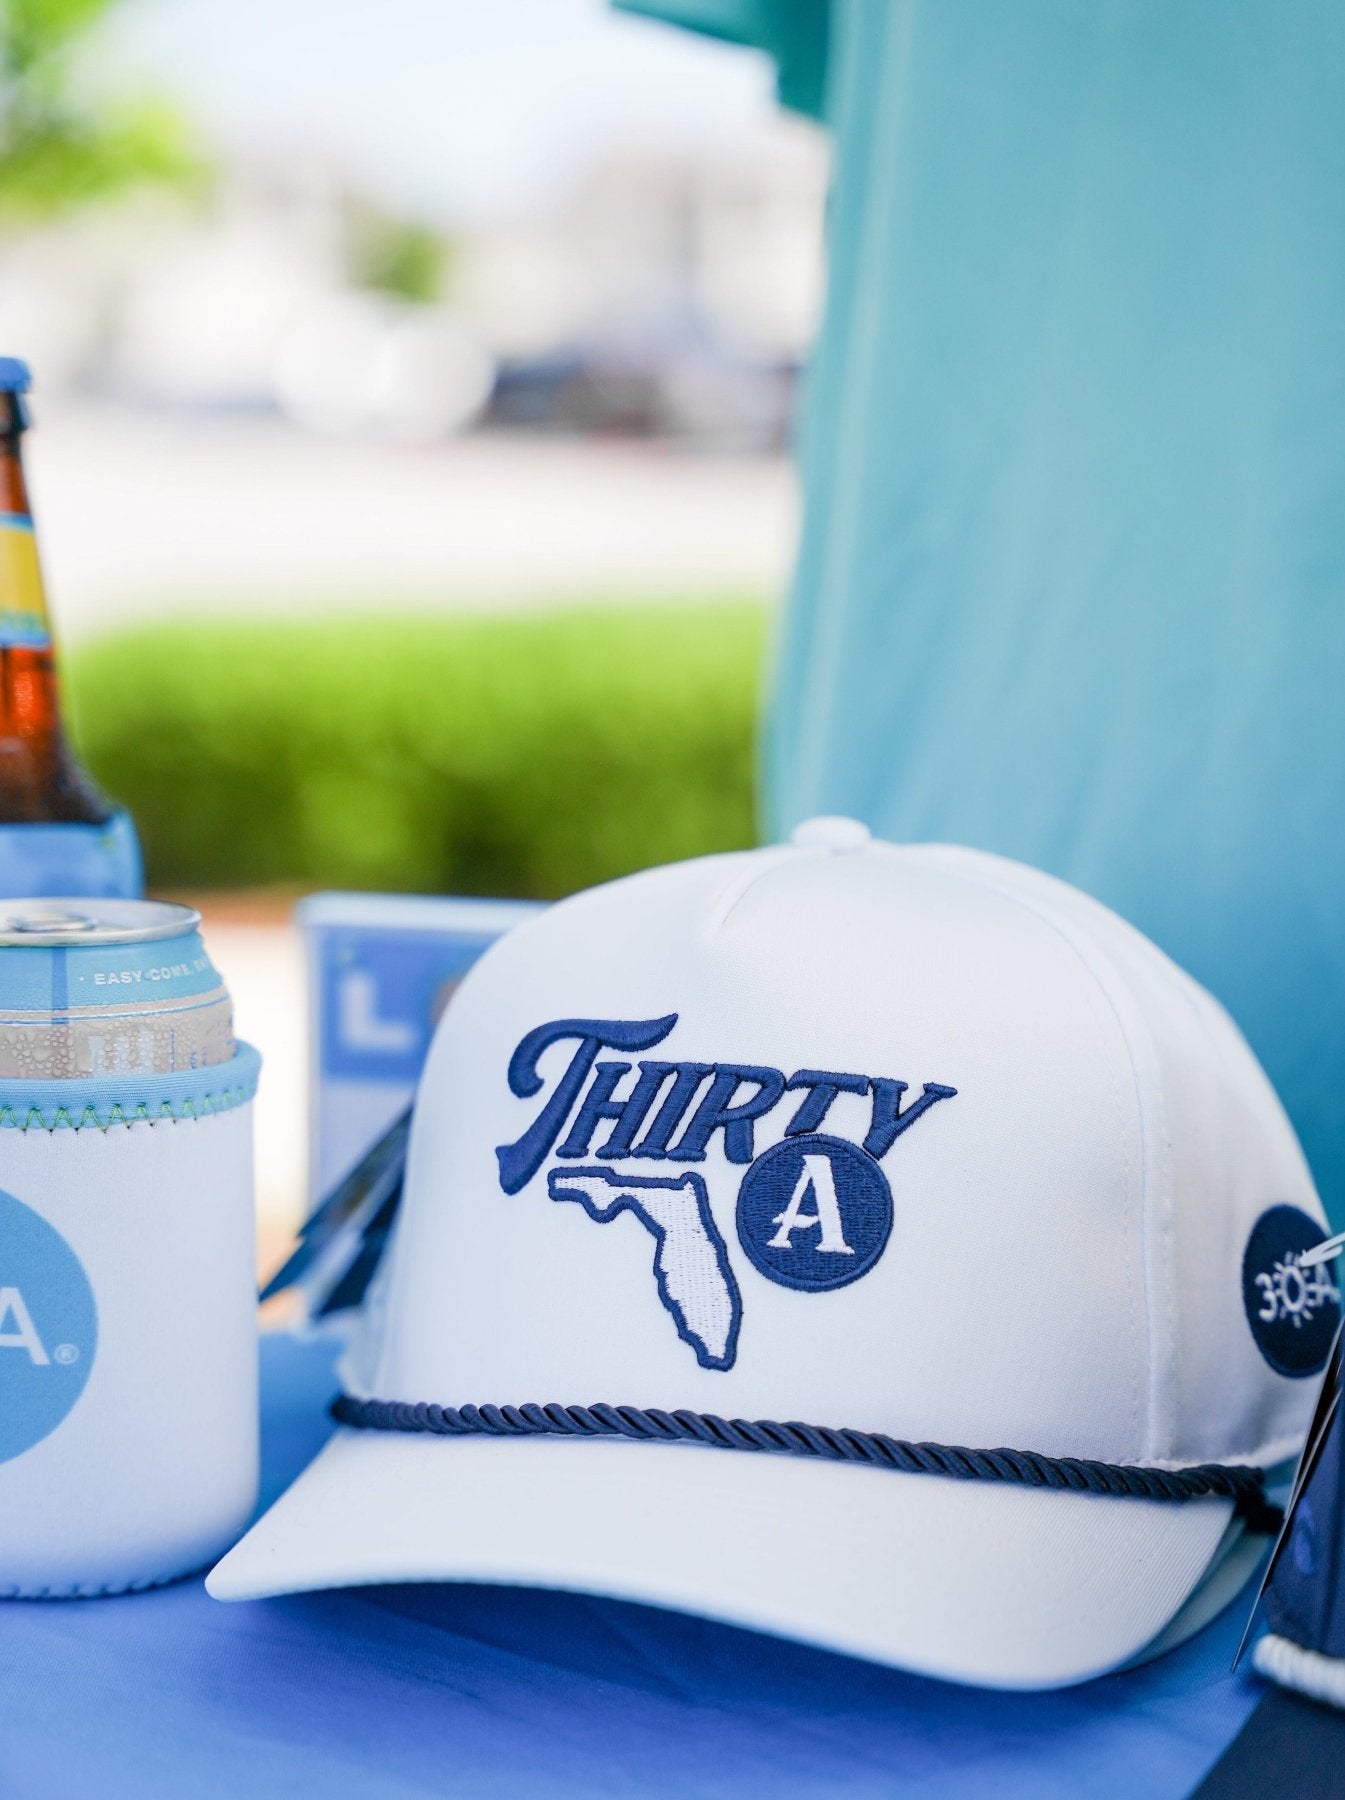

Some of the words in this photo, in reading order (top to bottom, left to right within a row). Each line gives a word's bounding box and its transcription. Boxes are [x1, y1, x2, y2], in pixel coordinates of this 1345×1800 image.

[94, 970, 142, 985] EASY
[149, 963, 190, 981] COME
[495, 1012, 958, 1196] THIRTY
[766, 1154, 856, 1255] A
